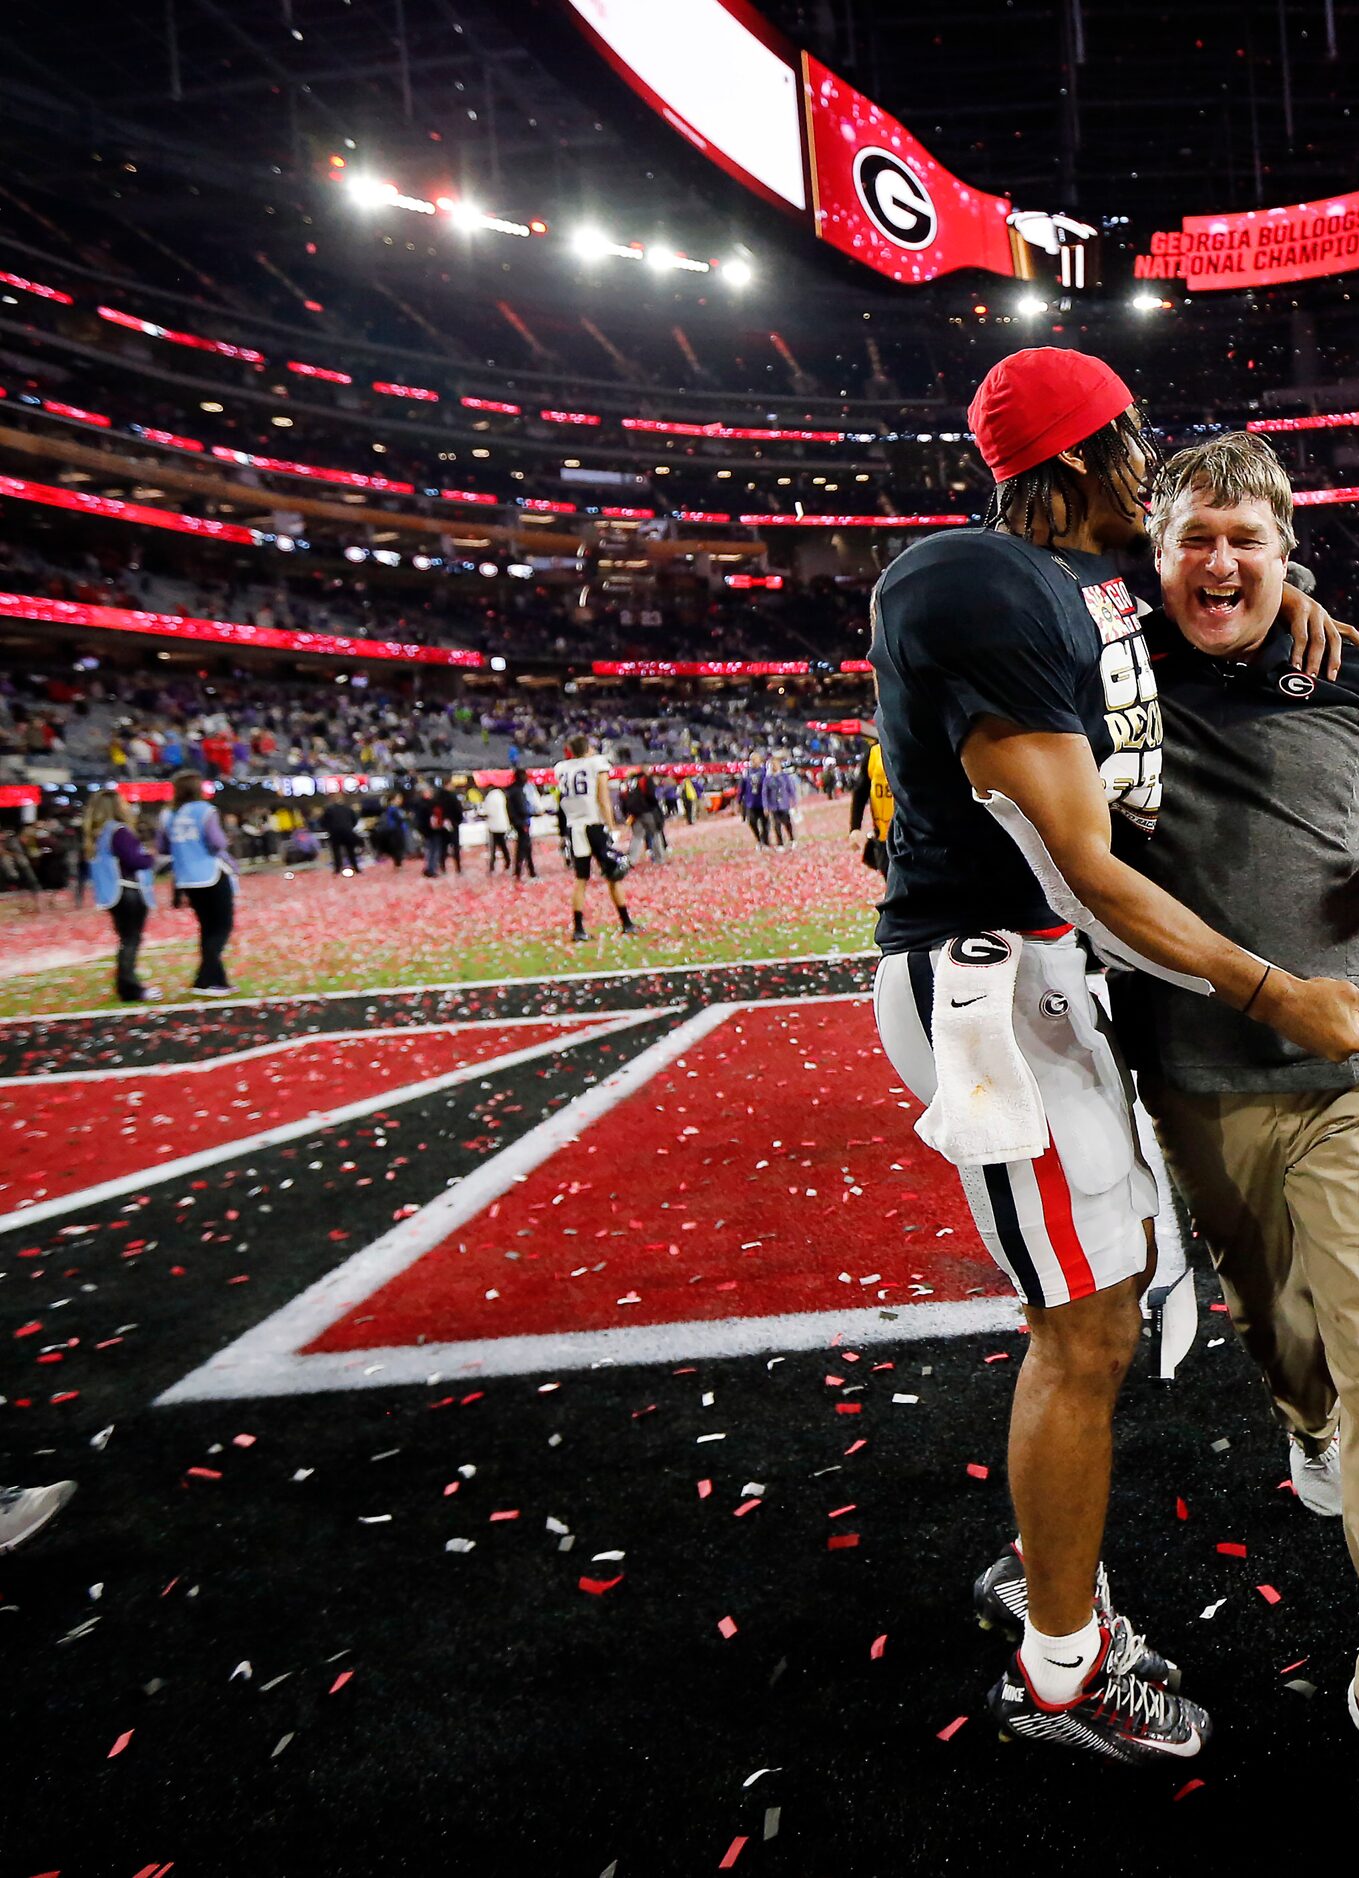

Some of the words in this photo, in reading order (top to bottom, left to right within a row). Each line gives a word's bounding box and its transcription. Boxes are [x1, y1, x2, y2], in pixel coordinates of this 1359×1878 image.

[1150, 226, 1251, 257] GEORGIA
[1133, 252, 1246, 279] NATIONAL
[1002, 1683, 1026, 1703] NIKE
